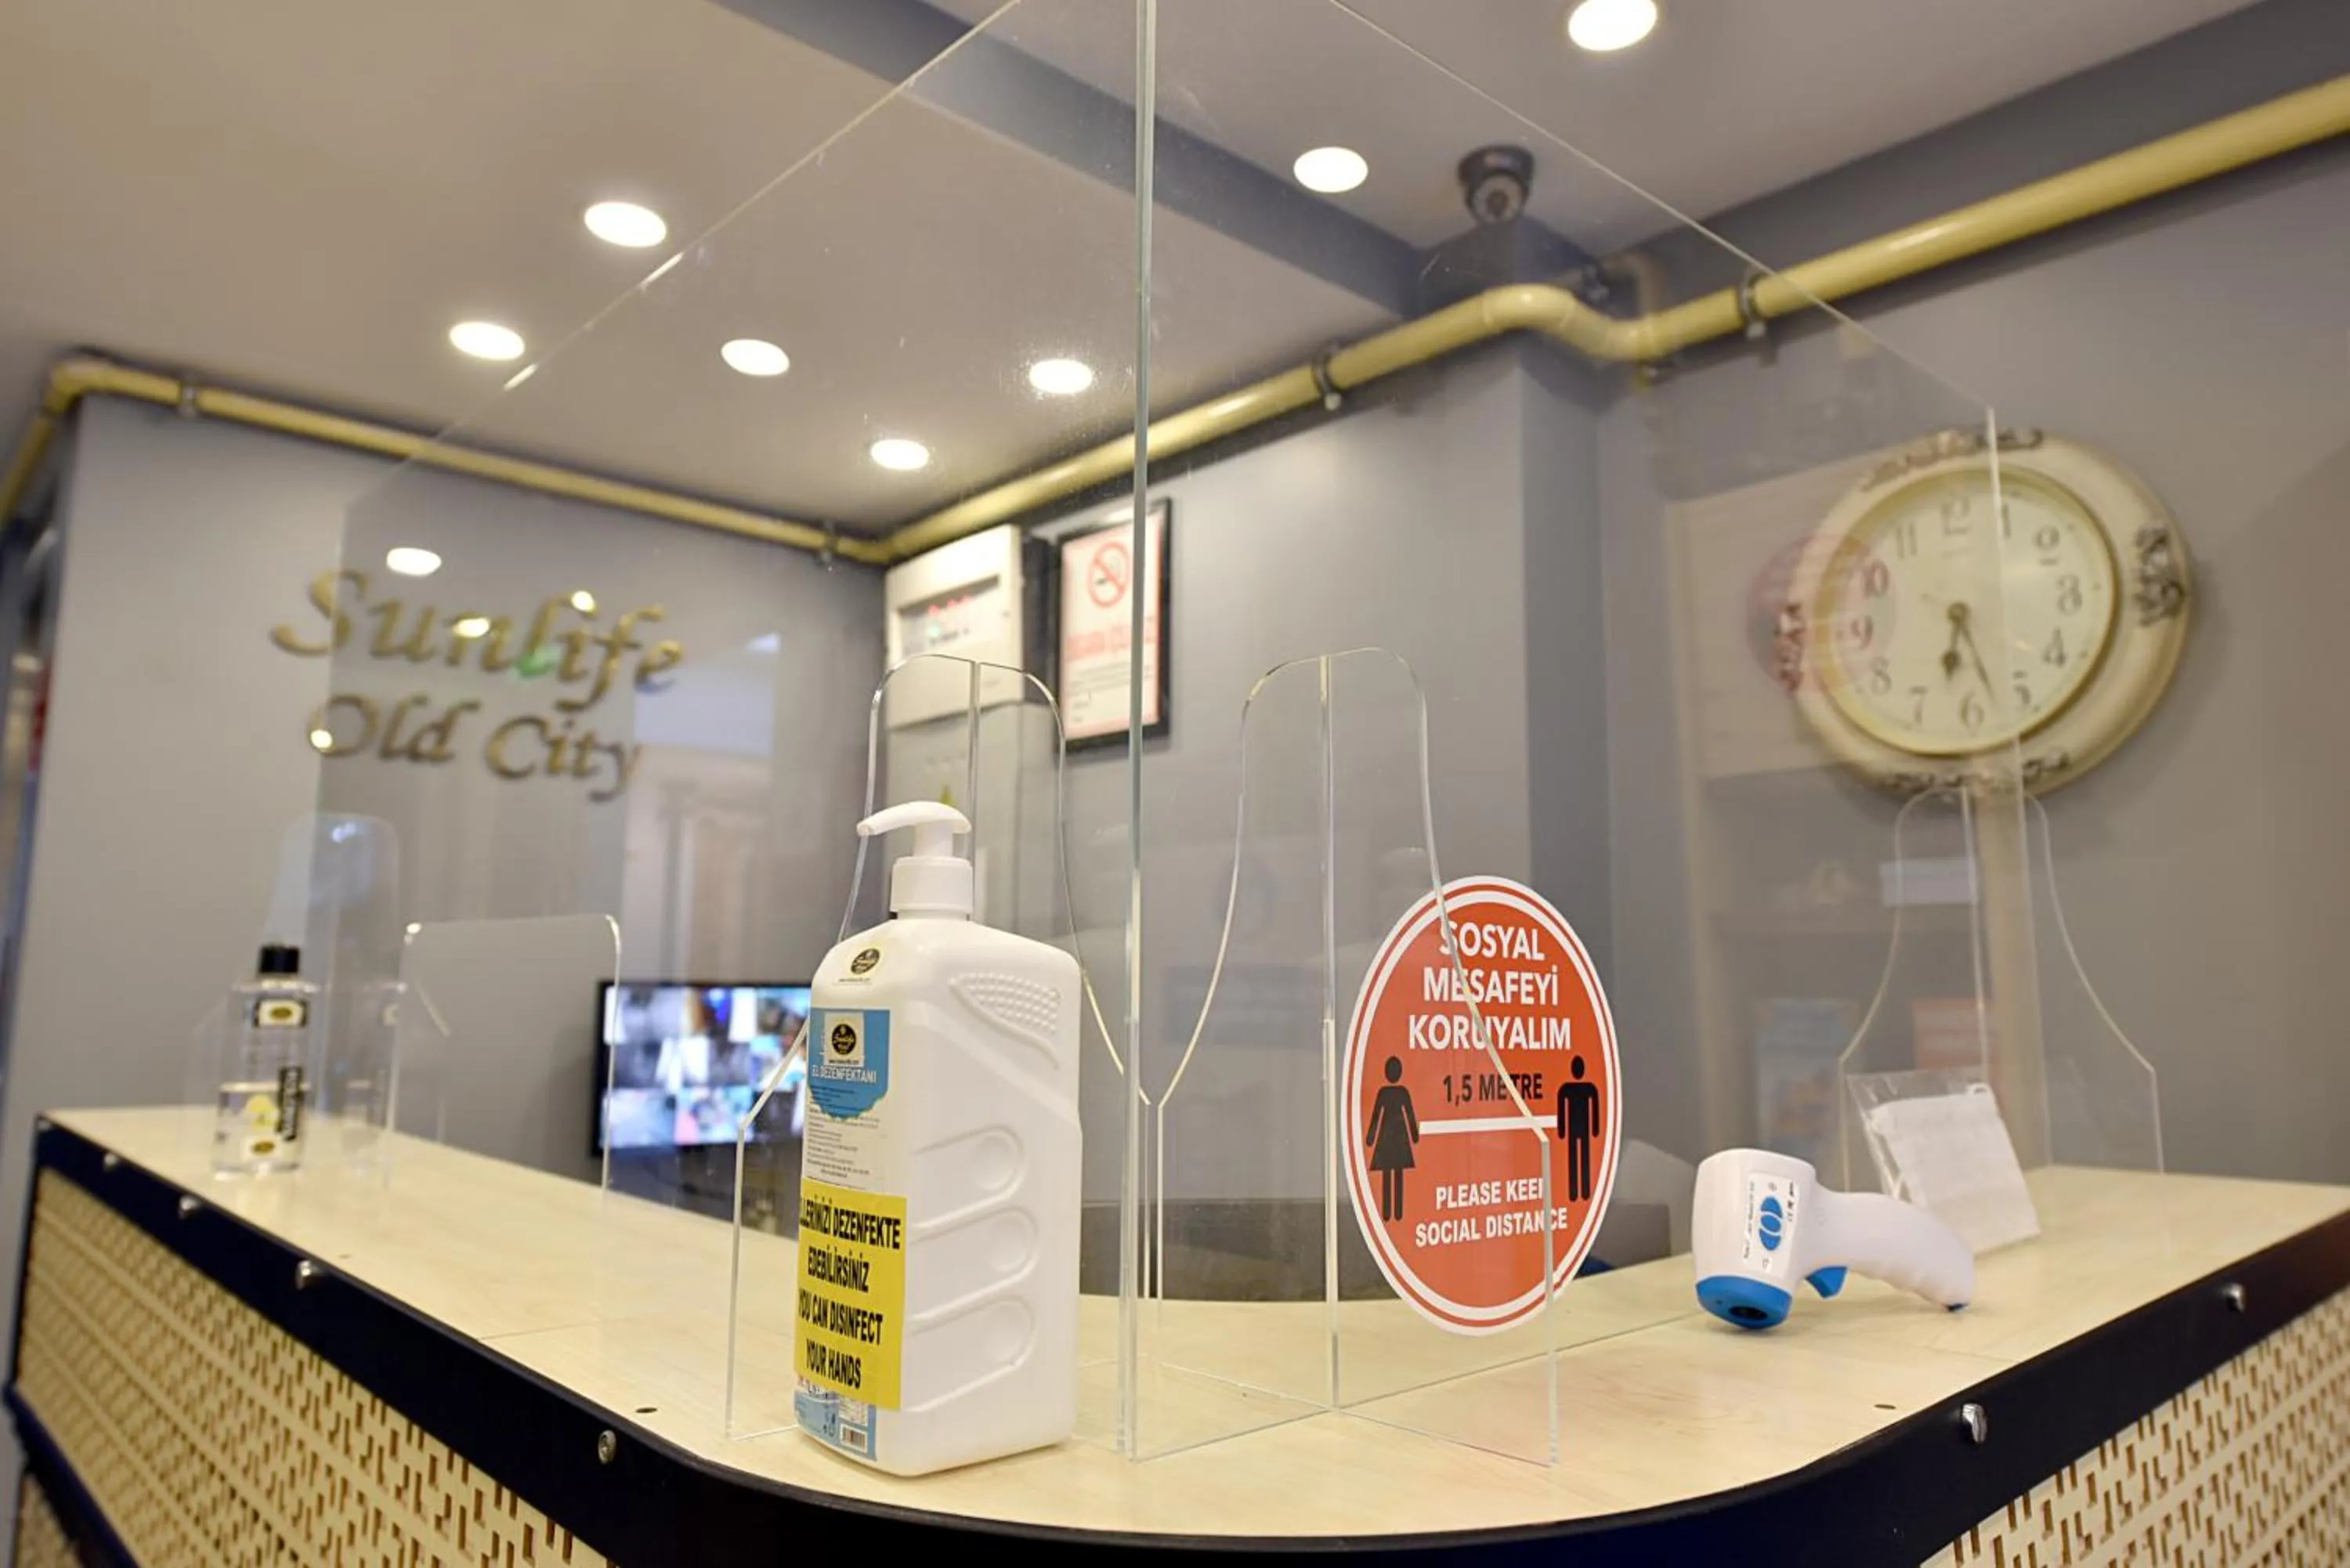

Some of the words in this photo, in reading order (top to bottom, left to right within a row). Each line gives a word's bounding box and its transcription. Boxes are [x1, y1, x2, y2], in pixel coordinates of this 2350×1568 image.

[1896, 522, 1918, 559] 11
[1862, 559, 1889, 599] 10
[269, 569, 685, 713] Sunlife
[1850, 614, 1873, 651] 9
[2041, 625, 2067, 668] 4
[1869, 656, 1892, 695] 8
[2012, 670, 2033, 709] 5
[1909, 685, 1929, 725] 7
[1959, 690, 1984, 730] 6
[306, 694, 481, 763] Old
[484, 714, 641, 804] City
[1439, 920, 1545, 960] SOSYAL
[1423, 964, 1558, 1006] MESAFEYİ
[1409, 1014, 1571, 1050] KORUYALIM
[1443, 1074, 1473, 1107] 1,5
[1478, 1073, 1543, 1101] METRE
[1436, 1180, 1502, 1211] PLEASE
[833, 1206, 900, 1250] DEZENFEKTE
[1415, 1218, 1481, 1248] SOCIAL
[1486, 1207, 1567, 1238] DISTANCE
[812, 1293, 829, 1329] CAN
[829, 1300, 884, 1346] DISINFECT
[806, 1338, 826, 1378] YOUR
[827, 1347, 861, 1389] HANDS
